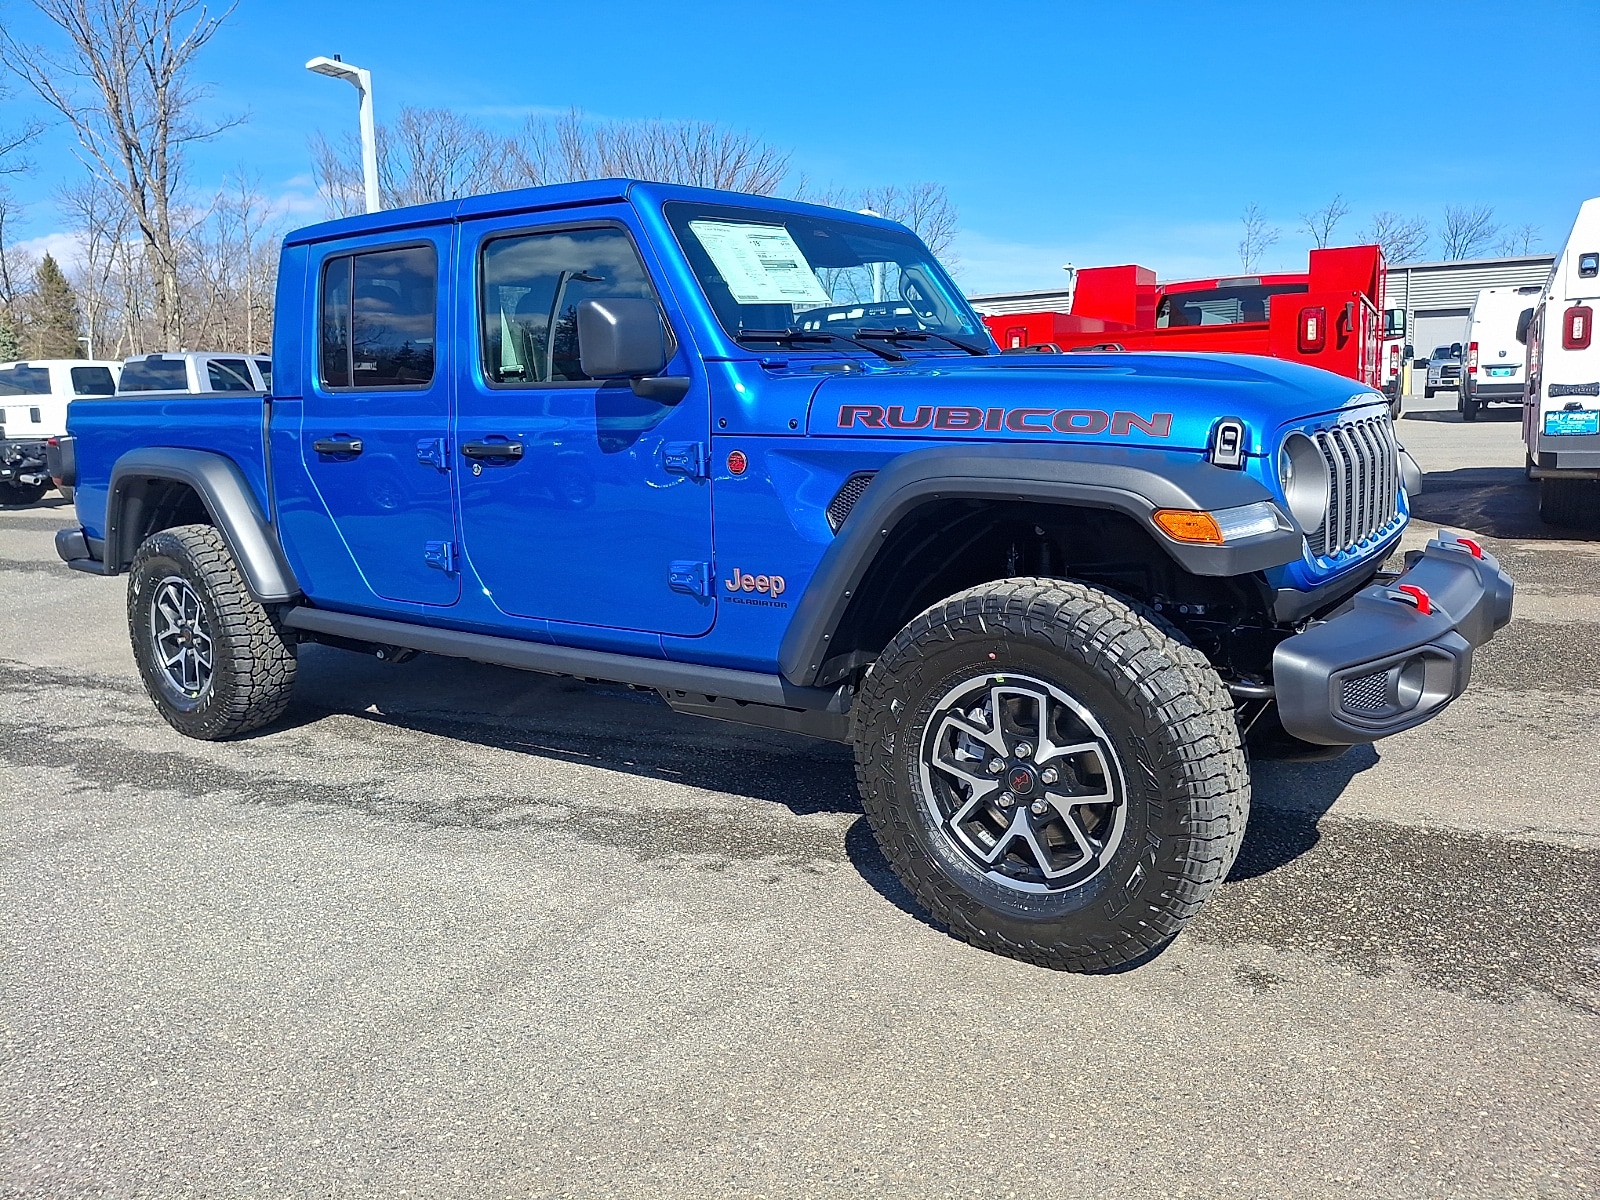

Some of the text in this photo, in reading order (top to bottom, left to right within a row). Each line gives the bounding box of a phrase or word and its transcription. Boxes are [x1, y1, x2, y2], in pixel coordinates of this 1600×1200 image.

[838, 404, 1173, 437] RUBICON
[725, 568, 785, 598] Jeep
[733, 597, 788, 609] GLADIATOR
